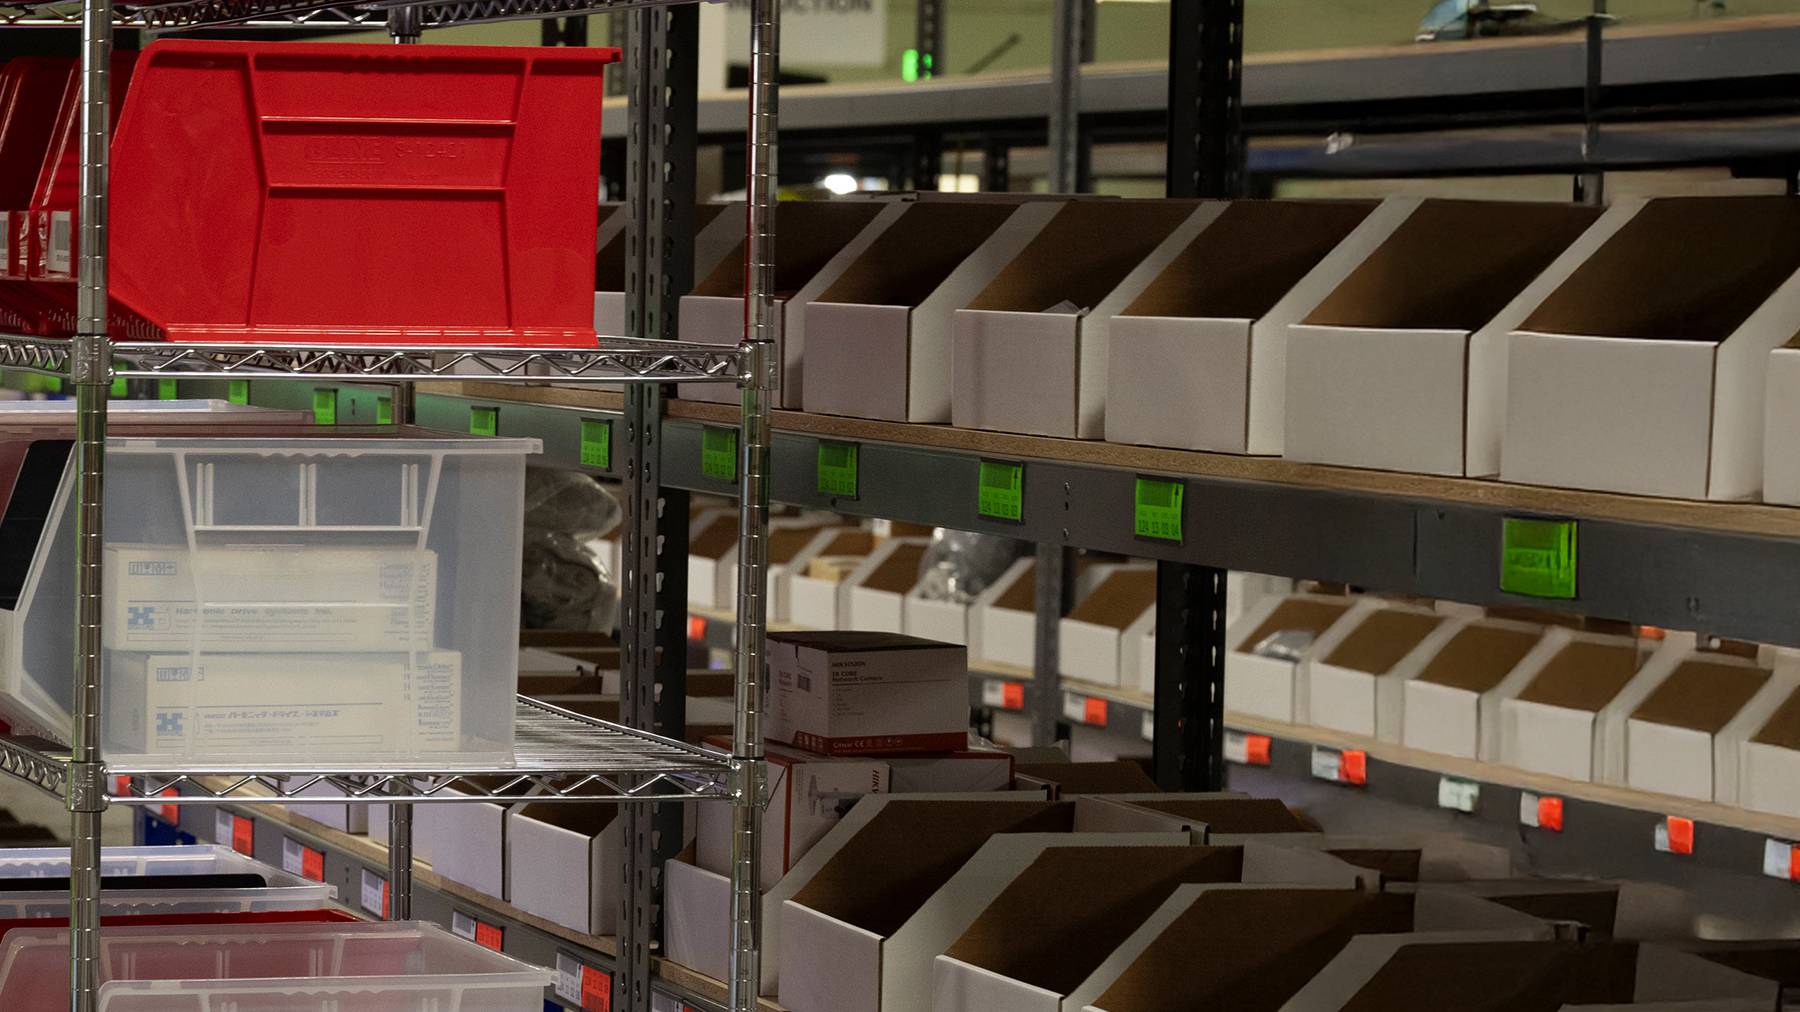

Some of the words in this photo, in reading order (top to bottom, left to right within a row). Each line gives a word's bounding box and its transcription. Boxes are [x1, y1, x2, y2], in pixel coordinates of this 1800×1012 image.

[1138, 519, 1149, 533] 124
[1151, 521, 1159, 534] 13
[230, 607, 258, 615] Drive
